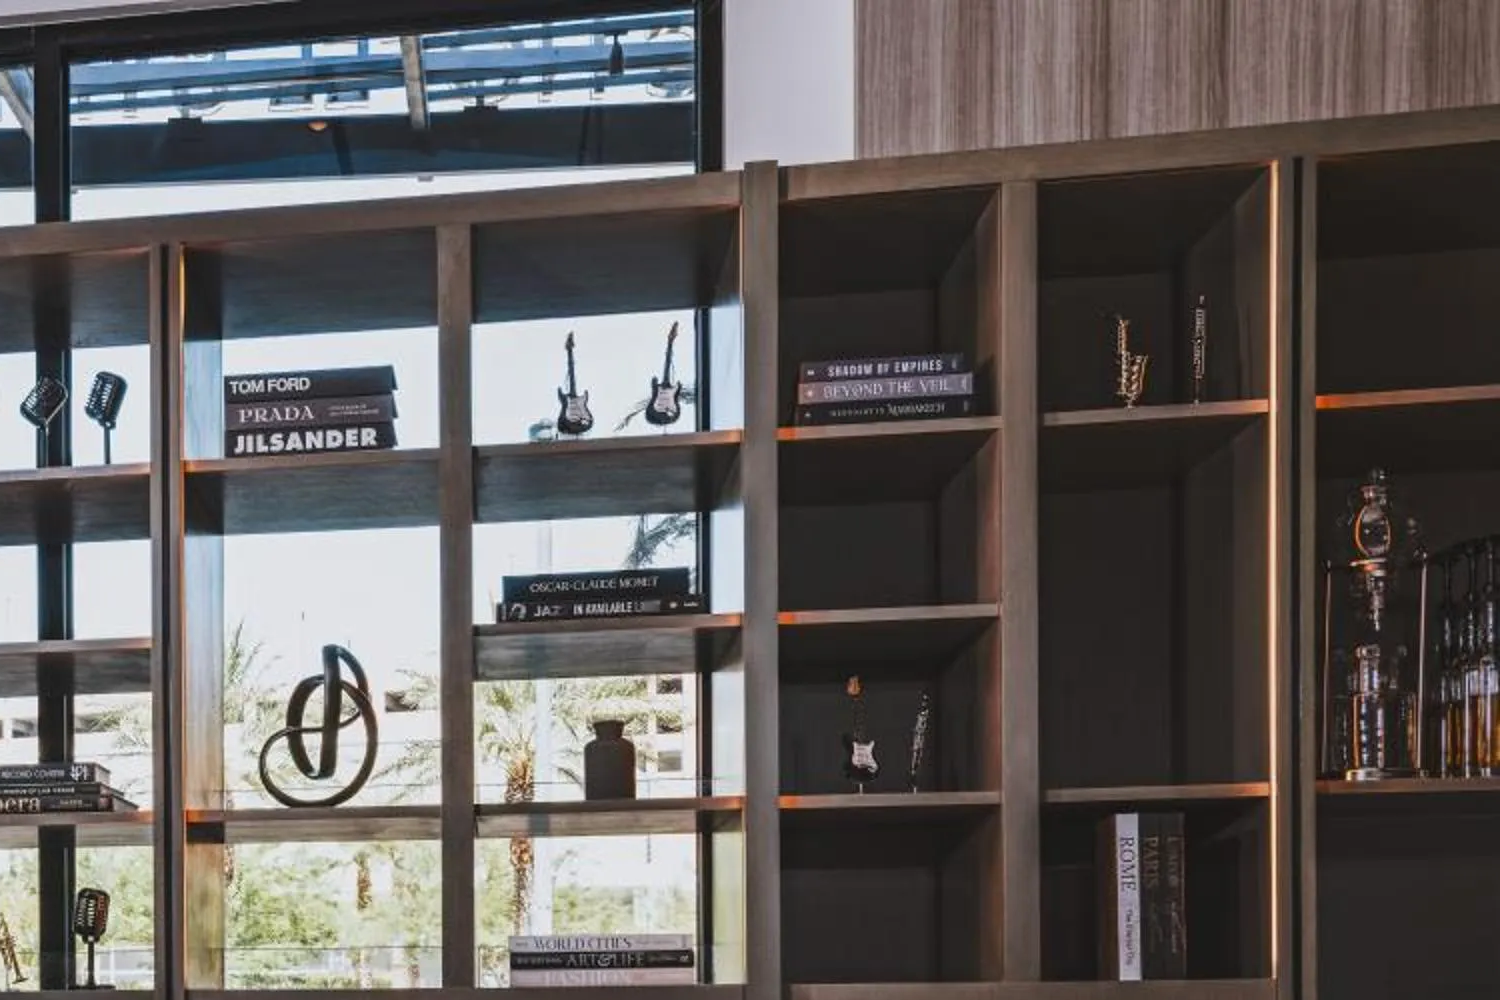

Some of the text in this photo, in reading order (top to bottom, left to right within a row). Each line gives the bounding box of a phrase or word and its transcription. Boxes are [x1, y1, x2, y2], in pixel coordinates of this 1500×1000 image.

[827, 364, 873, 377] SHADOW
[893, 359, 943, 373] EMPIRES
[229, 377, 311, 395] TOM FORD
[823, 378, 951, 399] BEYOND THE VEIL
[238, 405, 315, 424] PRADA
[1119, 836, 1138, 892] ROME
[533, 937, 585, 951] WORLD
